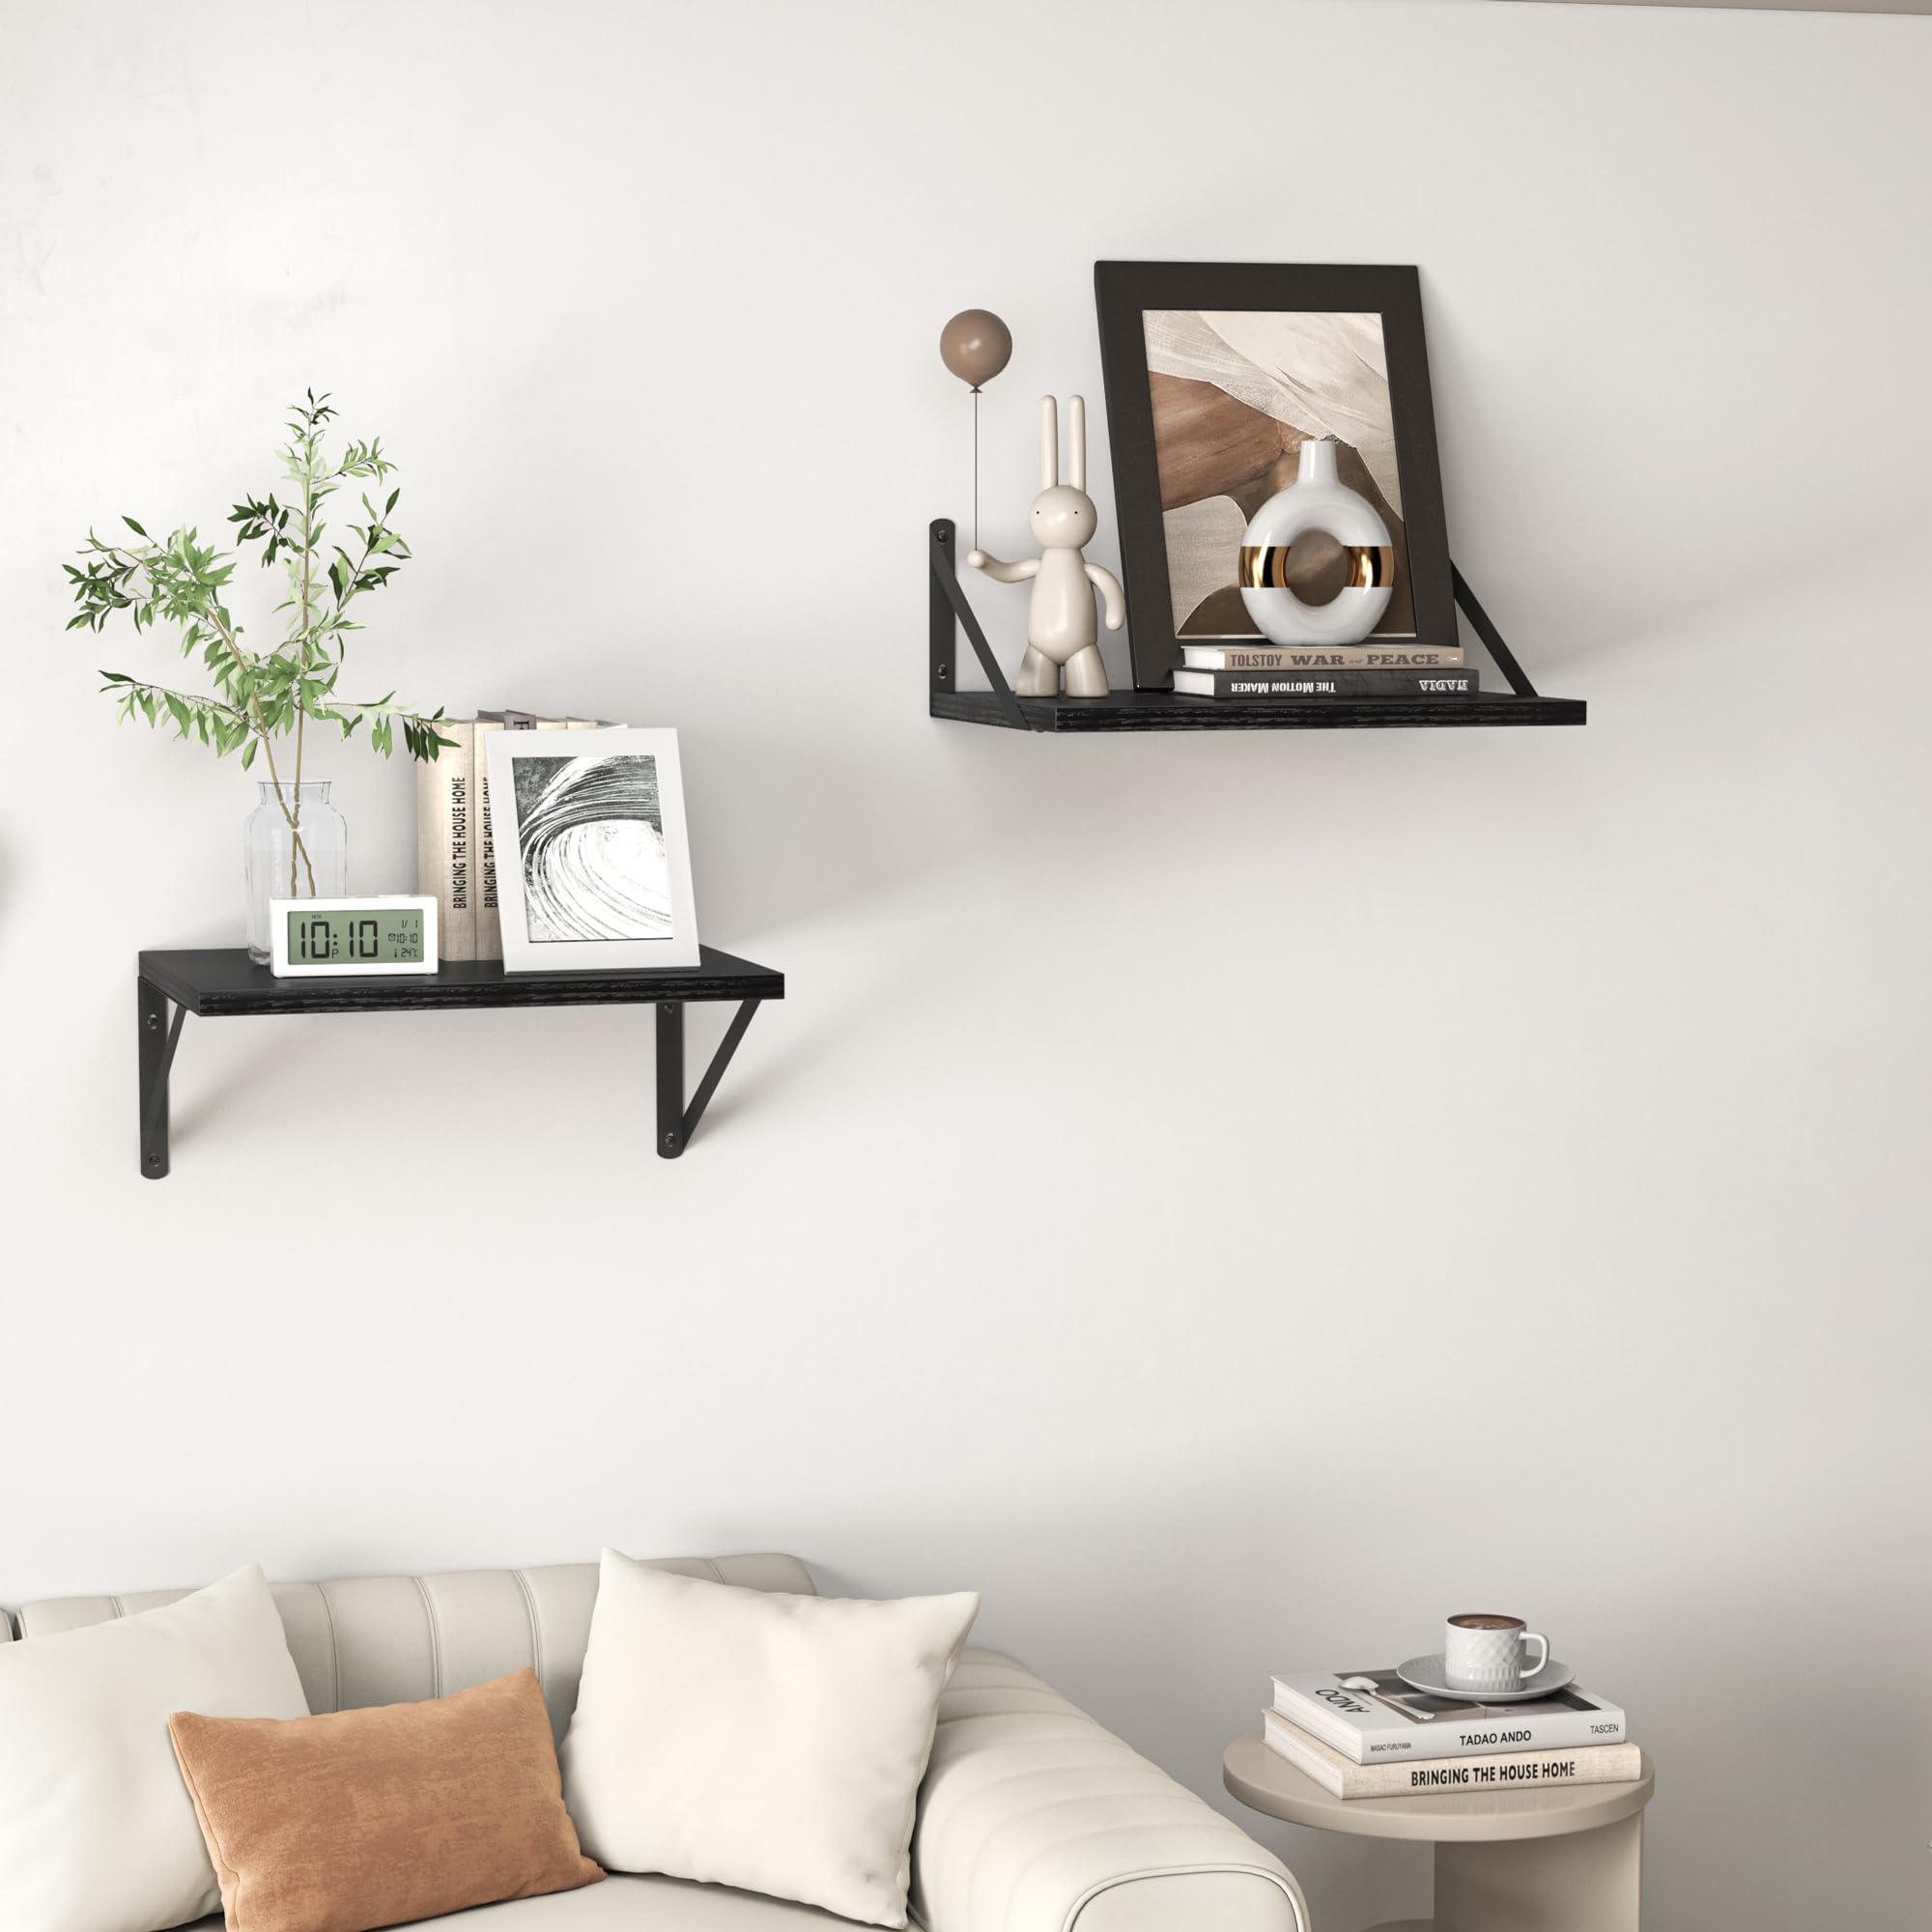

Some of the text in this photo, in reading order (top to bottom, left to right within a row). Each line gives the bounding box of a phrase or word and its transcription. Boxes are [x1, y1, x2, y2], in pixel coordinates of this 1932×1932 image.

[1230, 654, 1283, 667] TOLSTOY
[1291, 654, 1345, 666] WAR
[1367, 654, 1439, 666] PEACE
[1316, 682, 1336, 694] THE
[452, 777, 467, 909] BRINGING THE HOUSE HOME
[484, 862, 498, 908] BRINGING
[300, 921, 378, 958] 10:10
[1315, 1690, 1371, 1713] ANDO
[1459, 1730, 1532, 1747] TADAO ANDO
[1590, 1723, 1619, 1735] TASCEN
[1411, 1761, 1576, 1787] BRINGING THE HOUSE HOME
